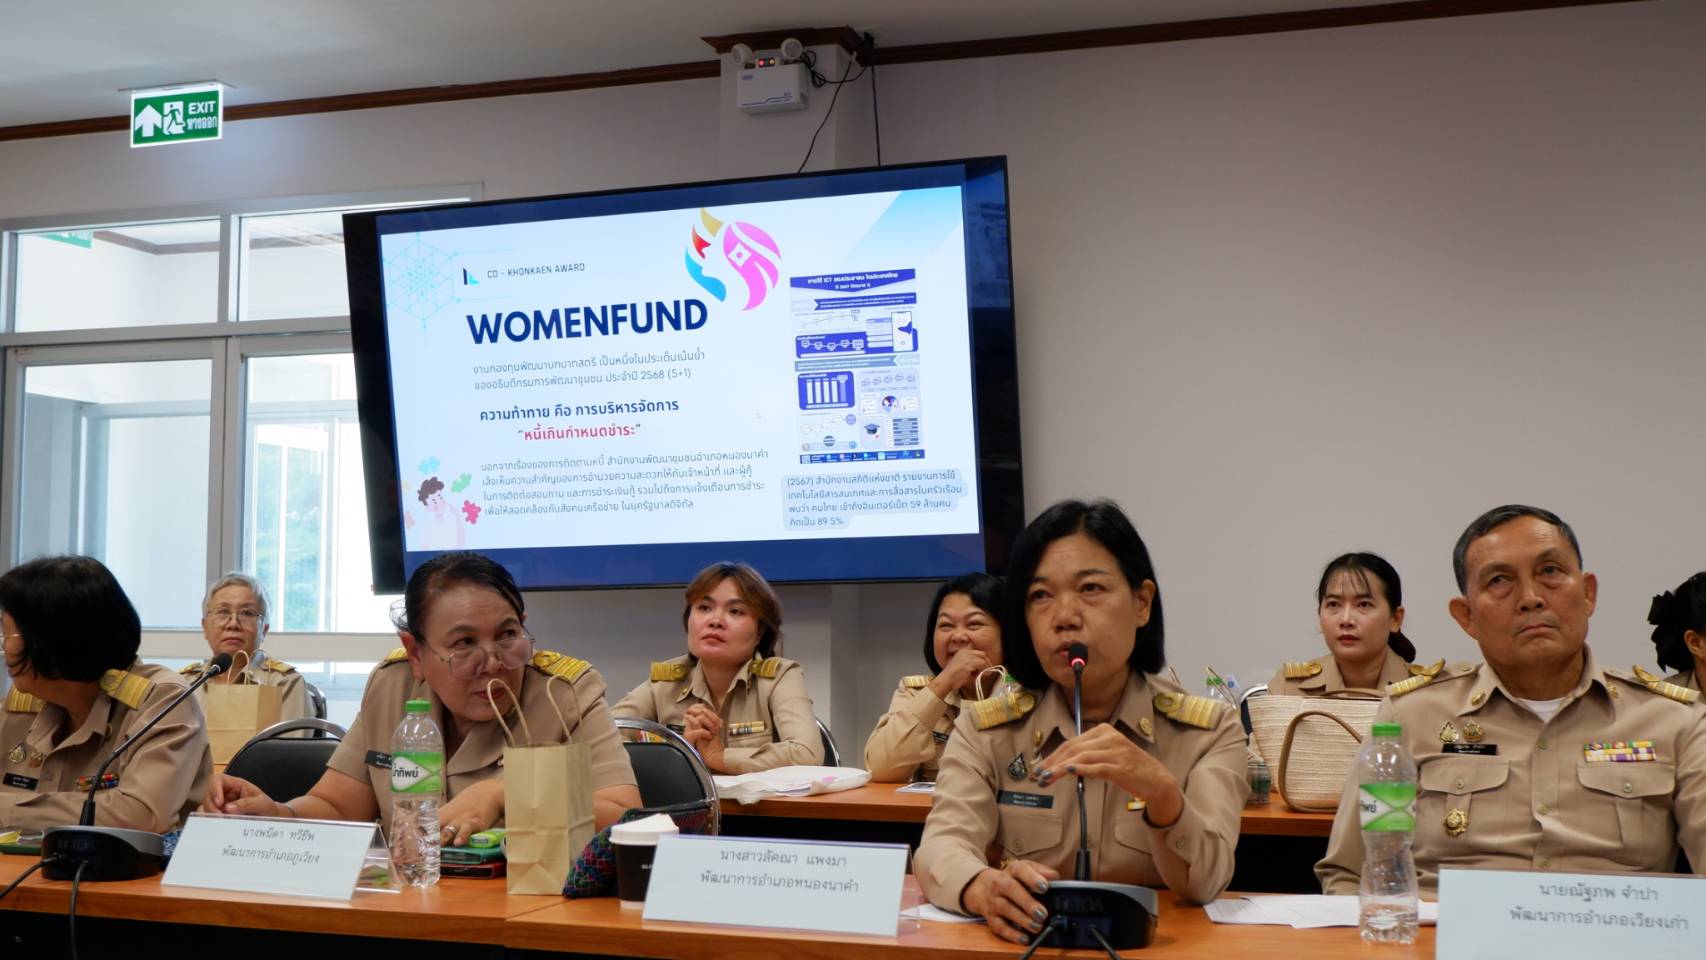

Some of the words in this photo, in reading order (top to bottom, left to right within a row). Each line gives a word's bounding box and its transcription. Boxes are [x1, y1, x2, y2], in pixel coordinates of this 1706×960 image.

[188, 101, 216, 114] EXIT
[187, 116, 217, 130] ทางออก
[487, 269, 499, 279] CD
[507, 264, 553, 277] KHONKAEN
[554, 262, 586, 274] AWARD
[466, 298, 709, 345] WOMENFUND
[473, 356, 598, 375] งานกองทุนพัฒนาบทบาทสตรี
[599, 347, 705, 367] เป็นหนึ่งในประเด็นเน้นย้ำ
[474, 374, 603, 391] ของอธิบดีกรมการพัฒนาชุมชน
[606, 369, 639, 383] ประจำปี
[640, 369, 665, 381] 2568
[667, 367, 692, 381] (5+1)
[480, 405, 550, 422] ความท้าทาย
[554, 402, 572, 418] คือ
[575, 400, 680, 417] การบริหารจัดการ
[787, 474, 814, 488] (2567)
[816, 472, 901, 486] สำนักงานสถิติแห่งชาติ
[902, 470, 956, 483] รายงานการใช้
[789, 502, 811, 514] พบว่า
[812, 501, 838, 513] คนไทย
[910, 500, 921, 510] 59
[923, 498, 952, 510] ล้านคน
[790, 516, 816, 528] คิดเป็น
[817, 516, 844, 527] 89.5%
[222, 844, 320, 866] พัฒนาการอำเภอภูเวียง
[806, 854, 848, 868] แพงมา
[700, 869, 859, 893] พัฒนาการอำเภอหนองนาคำ
[1539, 882, 1616, 902] นายณัฐภพ
[1622, 884, 1659, 902] จำปา
[1510, 905, 1690, 931] พัฒนาการอำเภอเวียงเก่า
